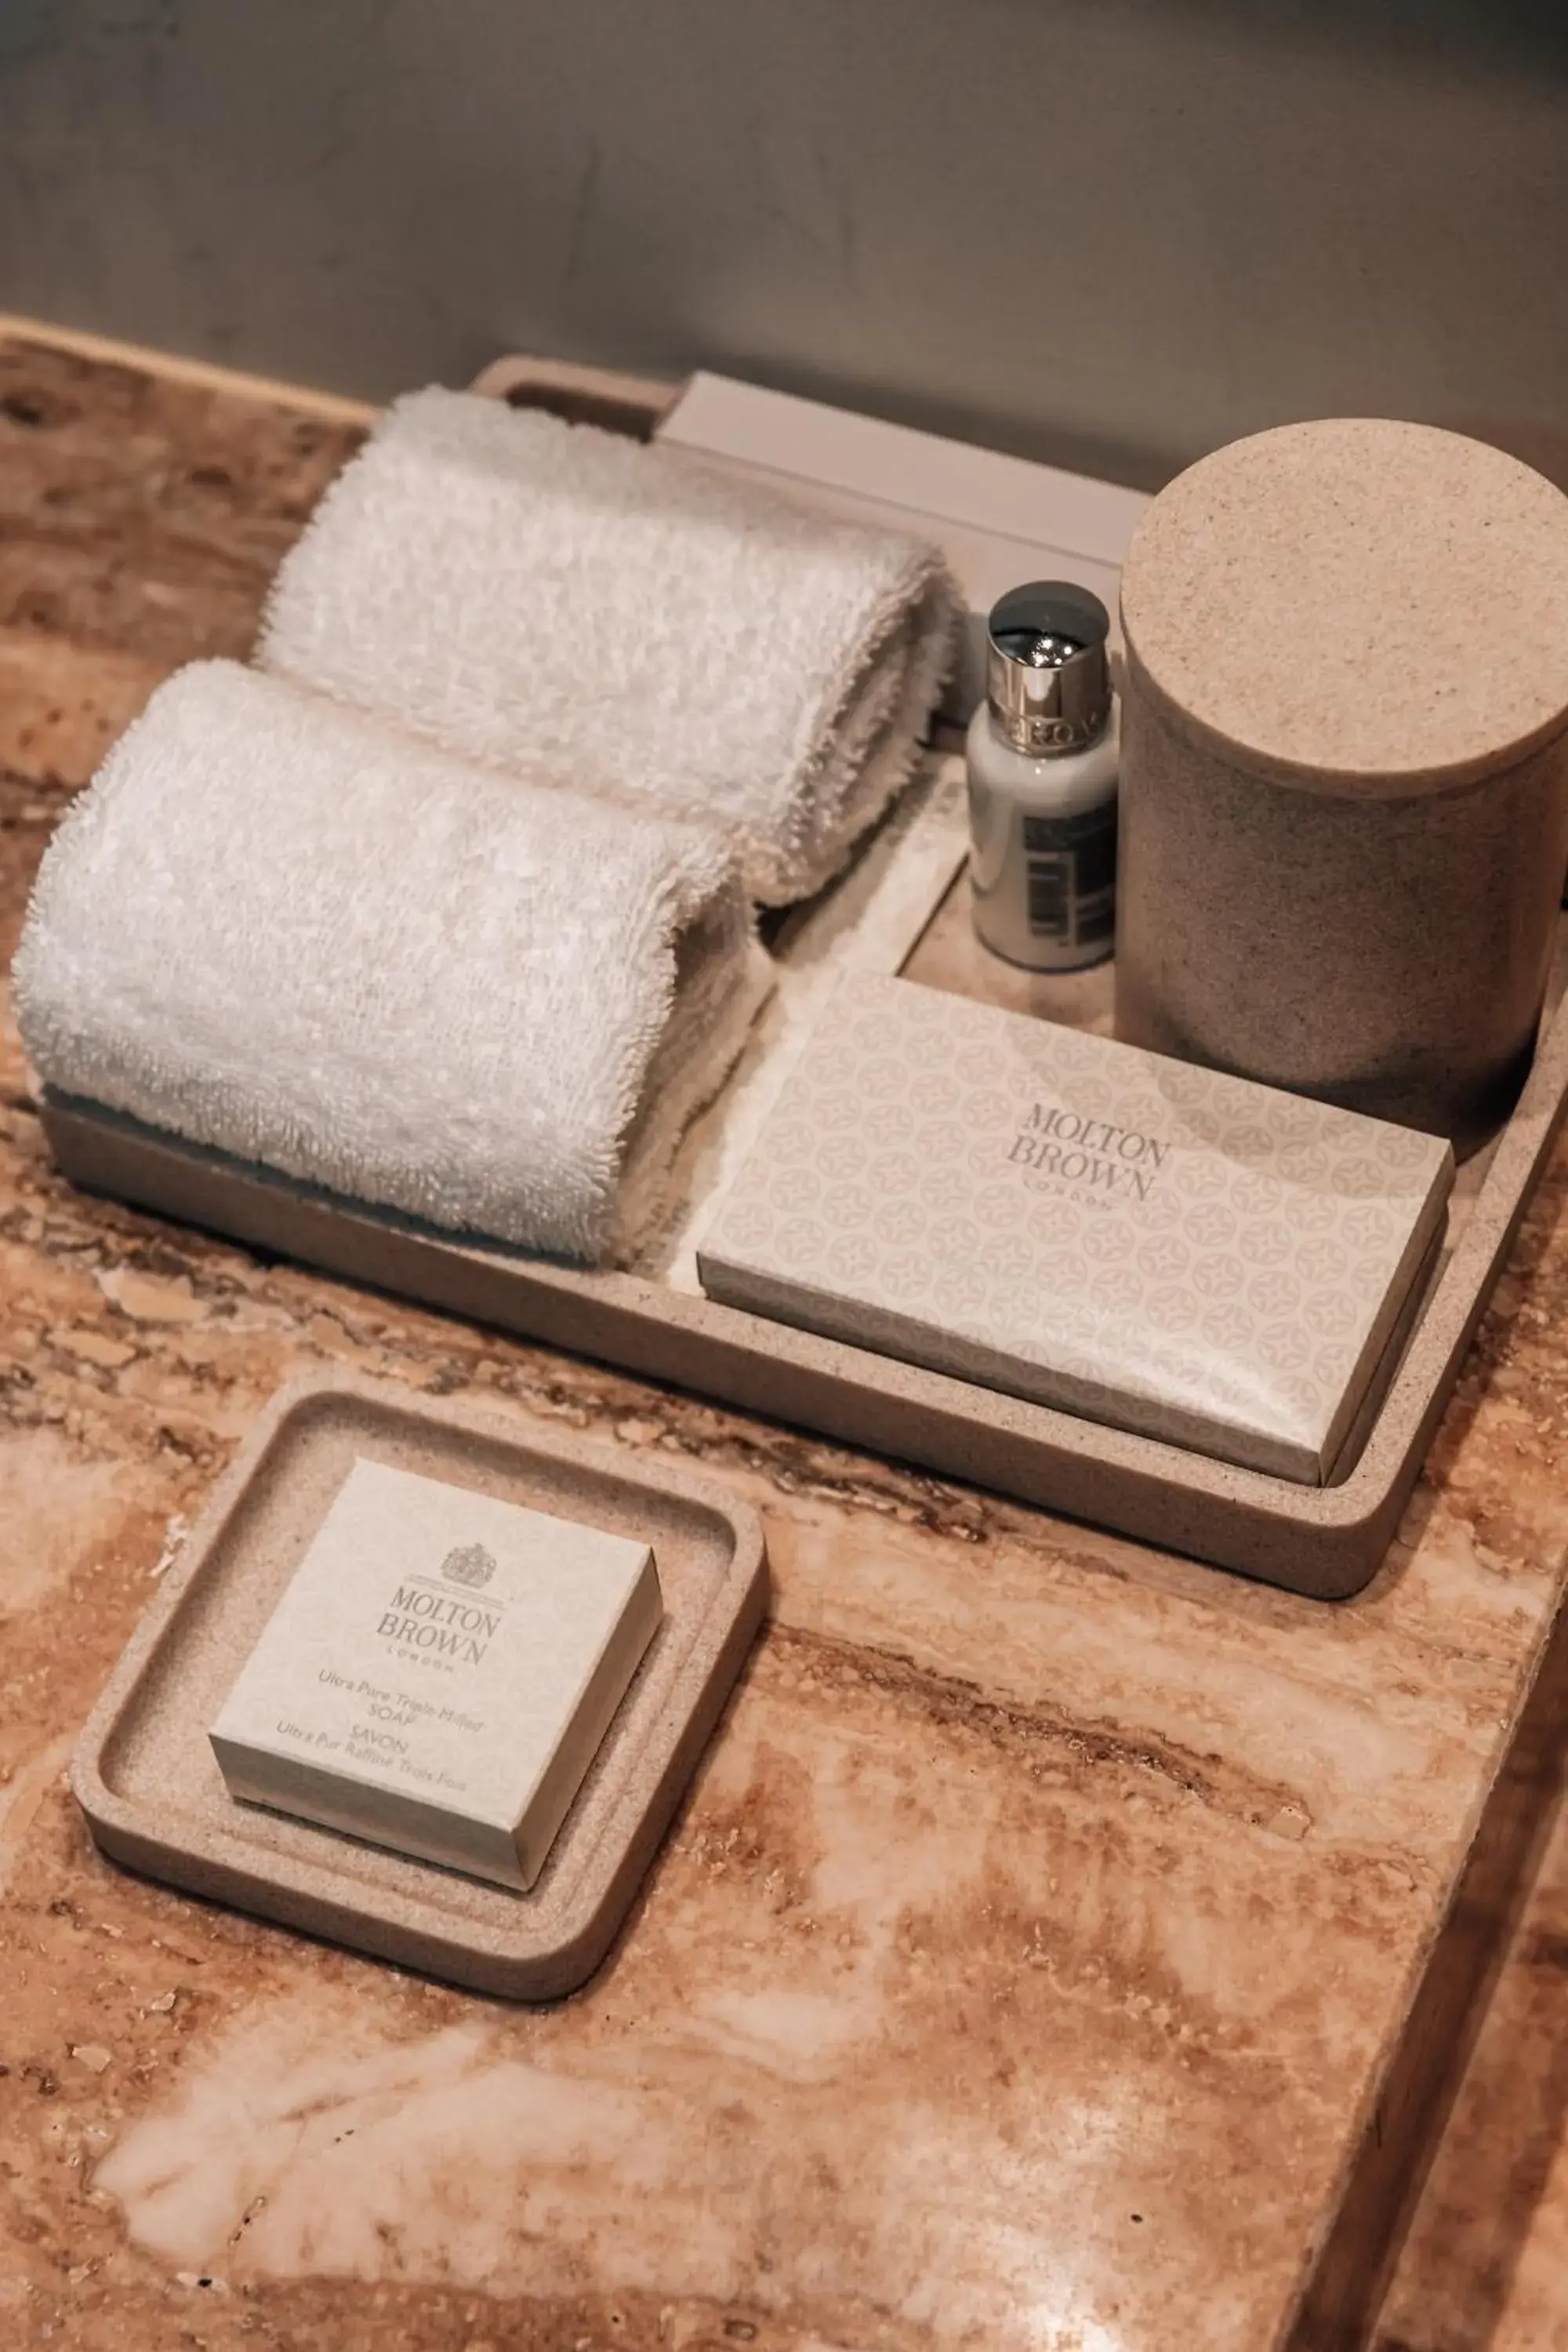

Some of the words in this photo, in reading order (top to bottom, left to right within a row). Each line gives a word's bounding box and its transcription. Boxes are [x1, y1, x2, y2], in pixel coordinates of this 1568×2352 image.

[1021, 1102, 1171, 1168] MOLTON
[1007, 1133, 1156, 1202] BROWN
[389, 1586, 501, 1638] MOLTON
[376, 1613, 488, 1665] BROWN
[318, 1668, 354, 1691] Ultra
[356, 1680, 391, 1702] Pure
[350, 1723, 408, 1755] SAVON
[366, 1703, 417, 1726] SOAP
